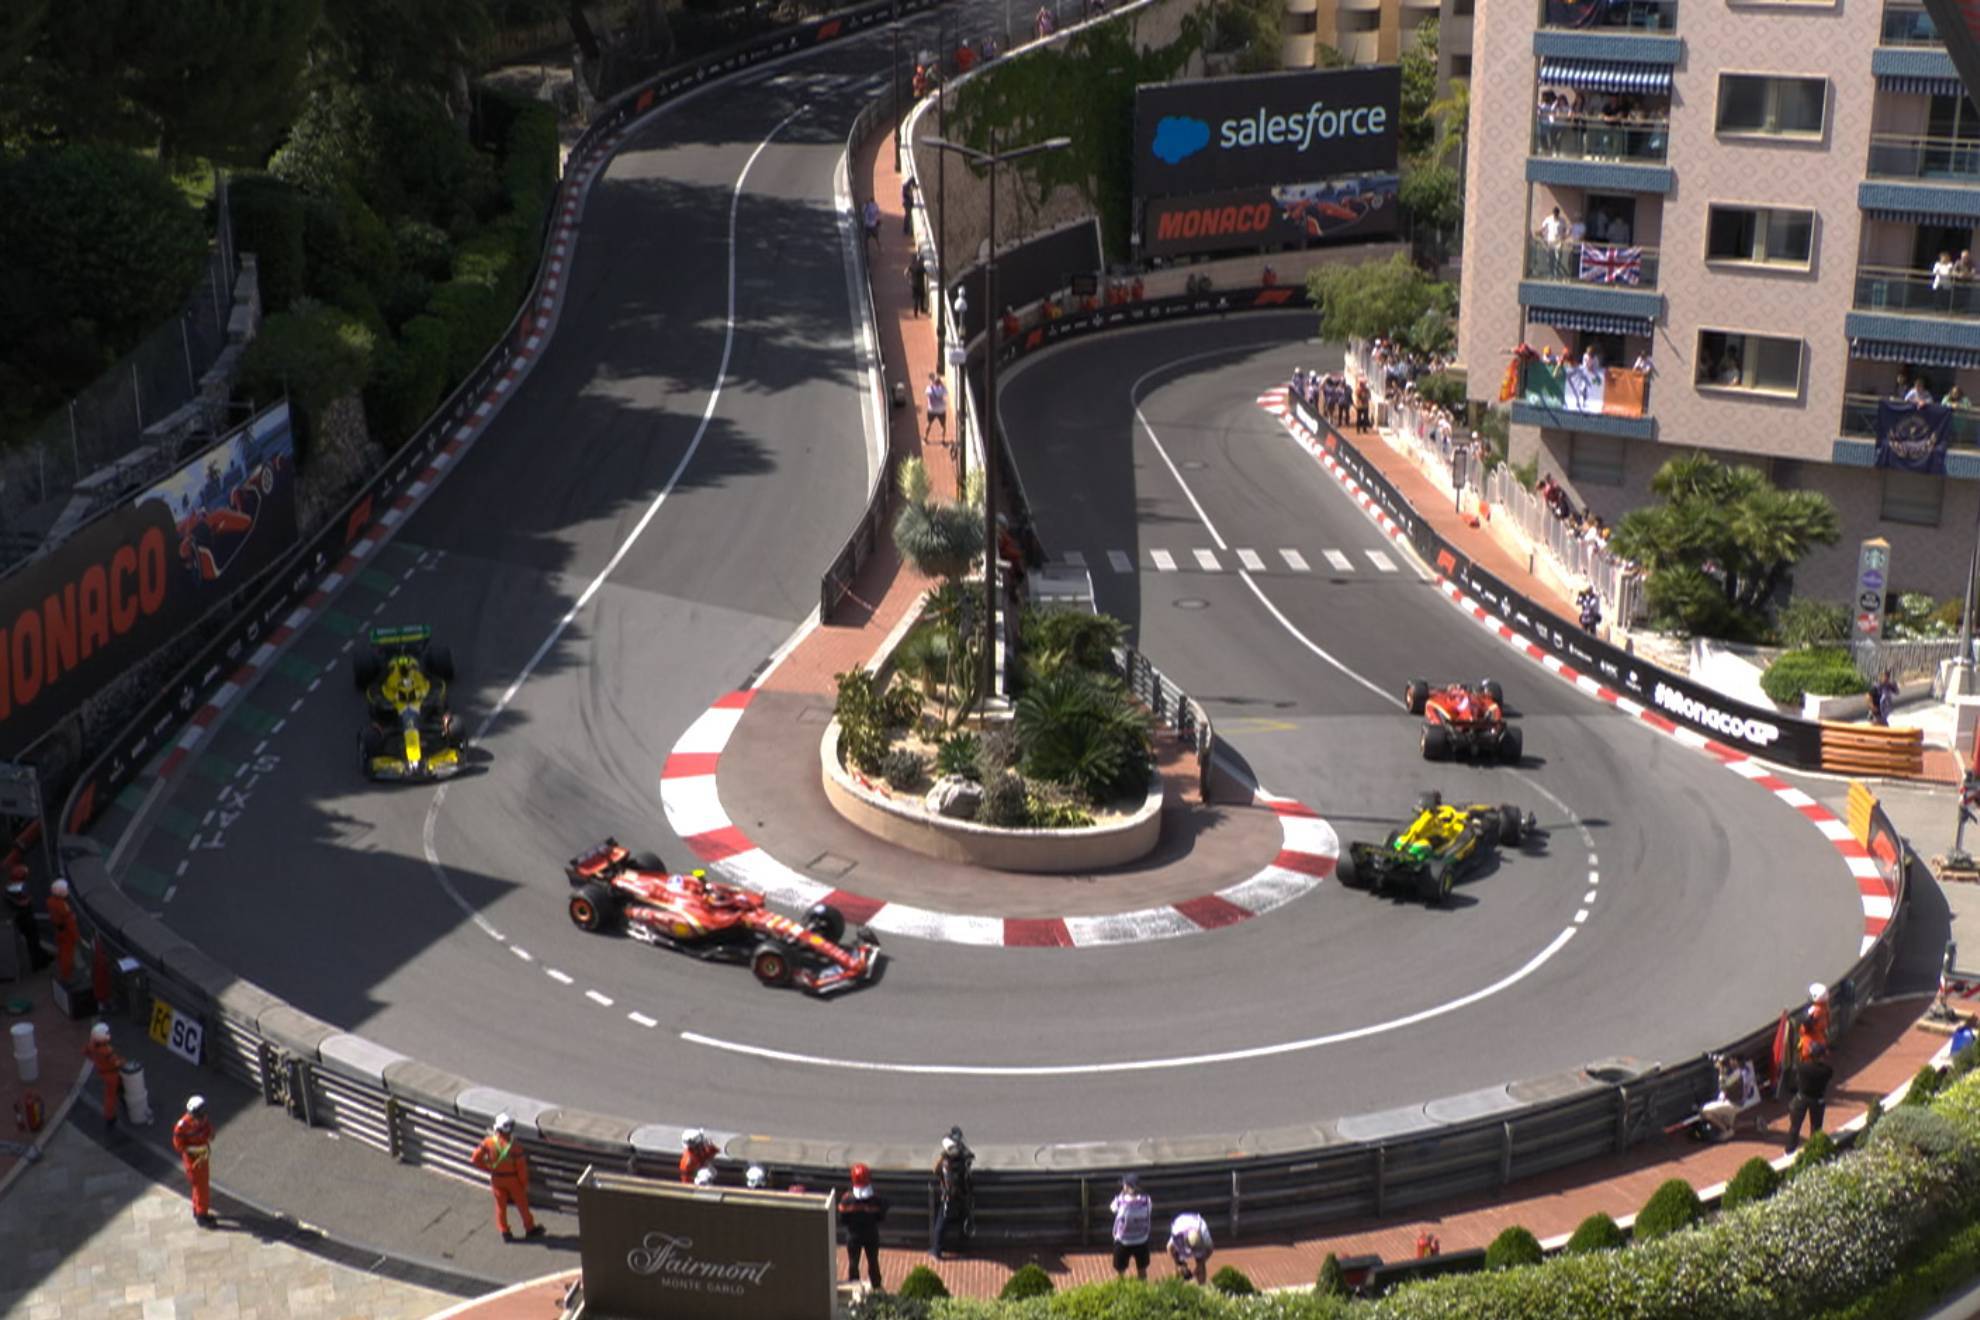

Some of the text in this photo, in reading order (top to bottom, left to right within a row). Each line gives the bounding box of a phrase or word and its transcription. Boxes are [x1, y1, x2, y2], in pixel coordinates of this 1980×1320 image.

[1220, 102, 1386, 151] salesforce
[1158, 204, 1271, 239] MONACO
[173, 1019, 198, 1055] SC
[627, 1231, 773, 1284] Fairmont
[662, 1277, 745, 1296] MONTE CARLO
